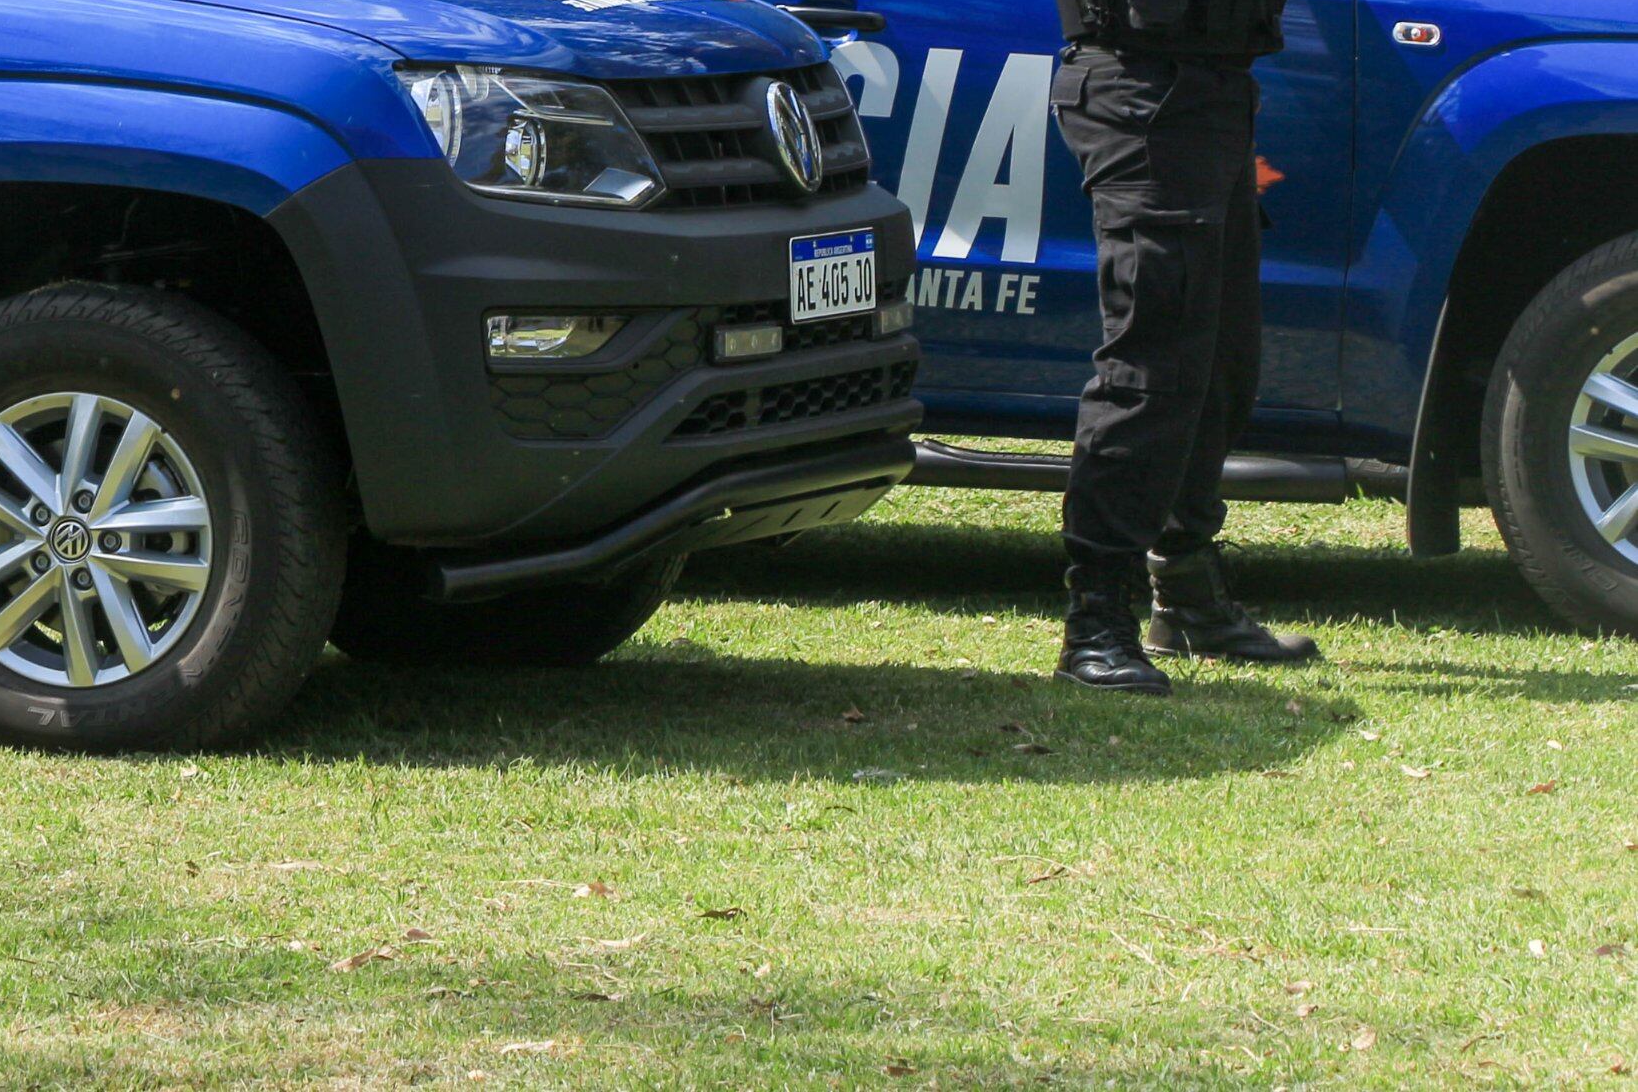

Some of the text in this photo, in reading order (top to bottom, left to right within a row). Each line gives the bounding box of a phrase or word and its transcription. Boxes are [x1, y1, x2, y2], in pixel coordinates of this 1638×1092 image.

[797, 257, 872, 312] AE 405 JO
[904, 268, 1041, 314] NTA FE
